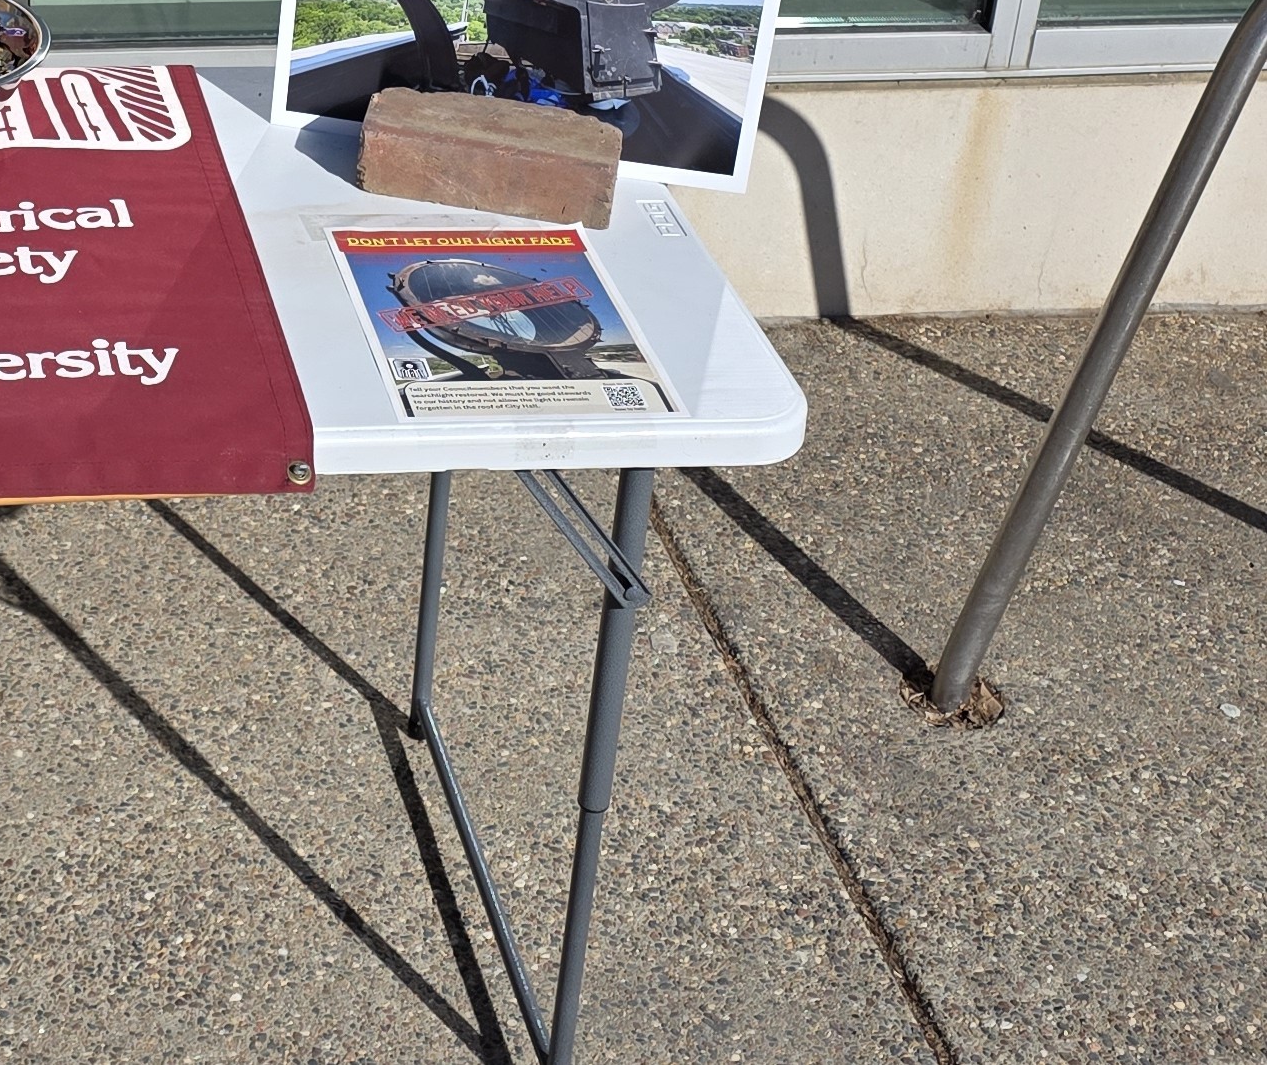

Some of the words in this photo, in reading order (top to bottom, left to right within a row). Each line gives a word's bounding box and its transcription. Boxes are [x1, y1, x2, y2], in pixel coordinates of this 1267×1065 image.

[346, 237, 400, 246] DON'T
[404, 237, 432, 246] LET
[437, 237, 473, 246] OUR
[477, 237, 526, 246] LIGHT
[531, 237, 573, 245] FADE
[426, 298, 479, 322] NEED
[481, 289, 533, 313] YOUR
[533, 278, 581, 304] HELP
